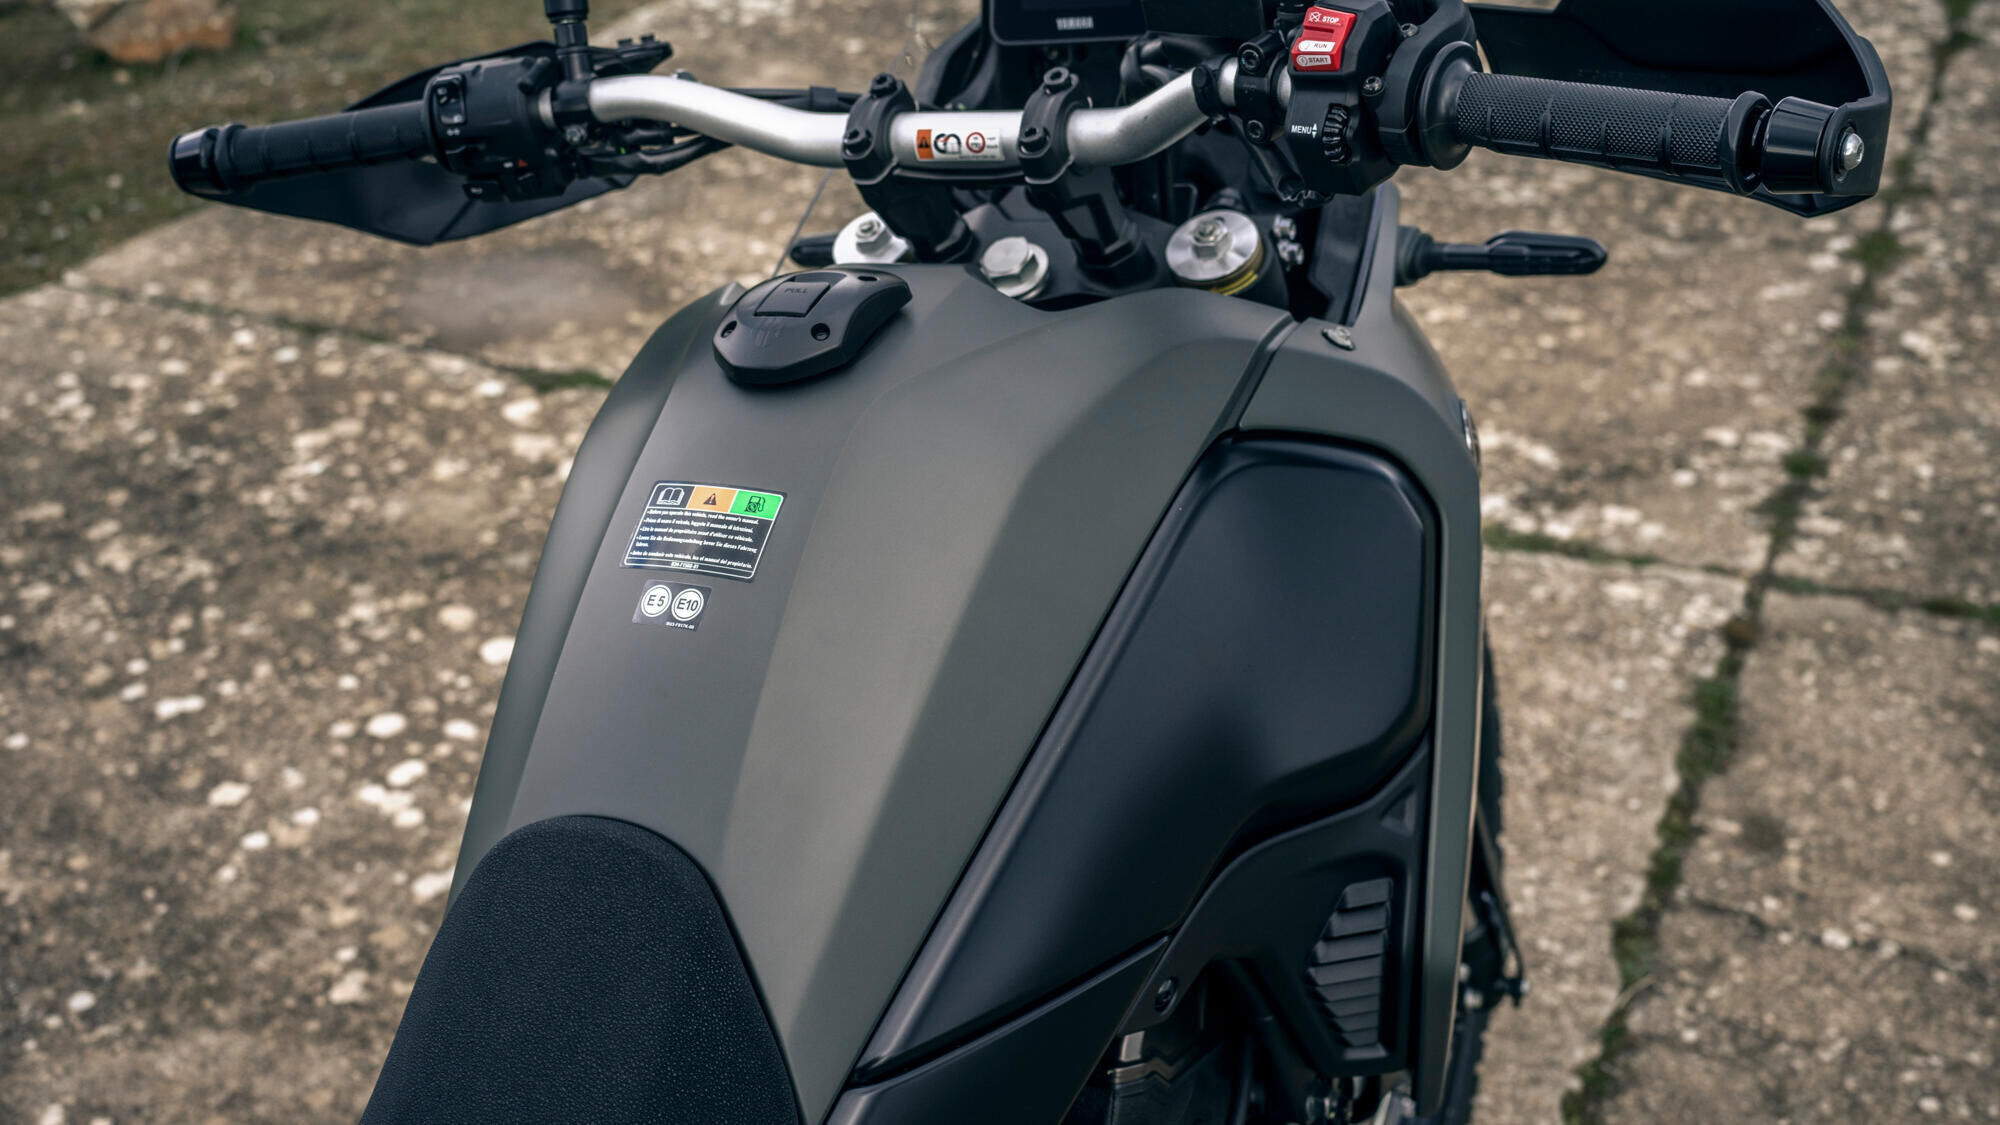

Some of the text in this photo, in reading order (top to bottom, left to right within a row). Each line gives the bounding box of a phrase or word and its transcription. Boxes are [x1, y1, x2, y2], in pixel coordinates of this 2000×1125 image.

[1056, 16, 1094, 31] YAMAHA
[1322, 15, 1340, 24] STOP
[1291, 124, 1313, 135] MENU
[677, 598, 699, 612] E10
